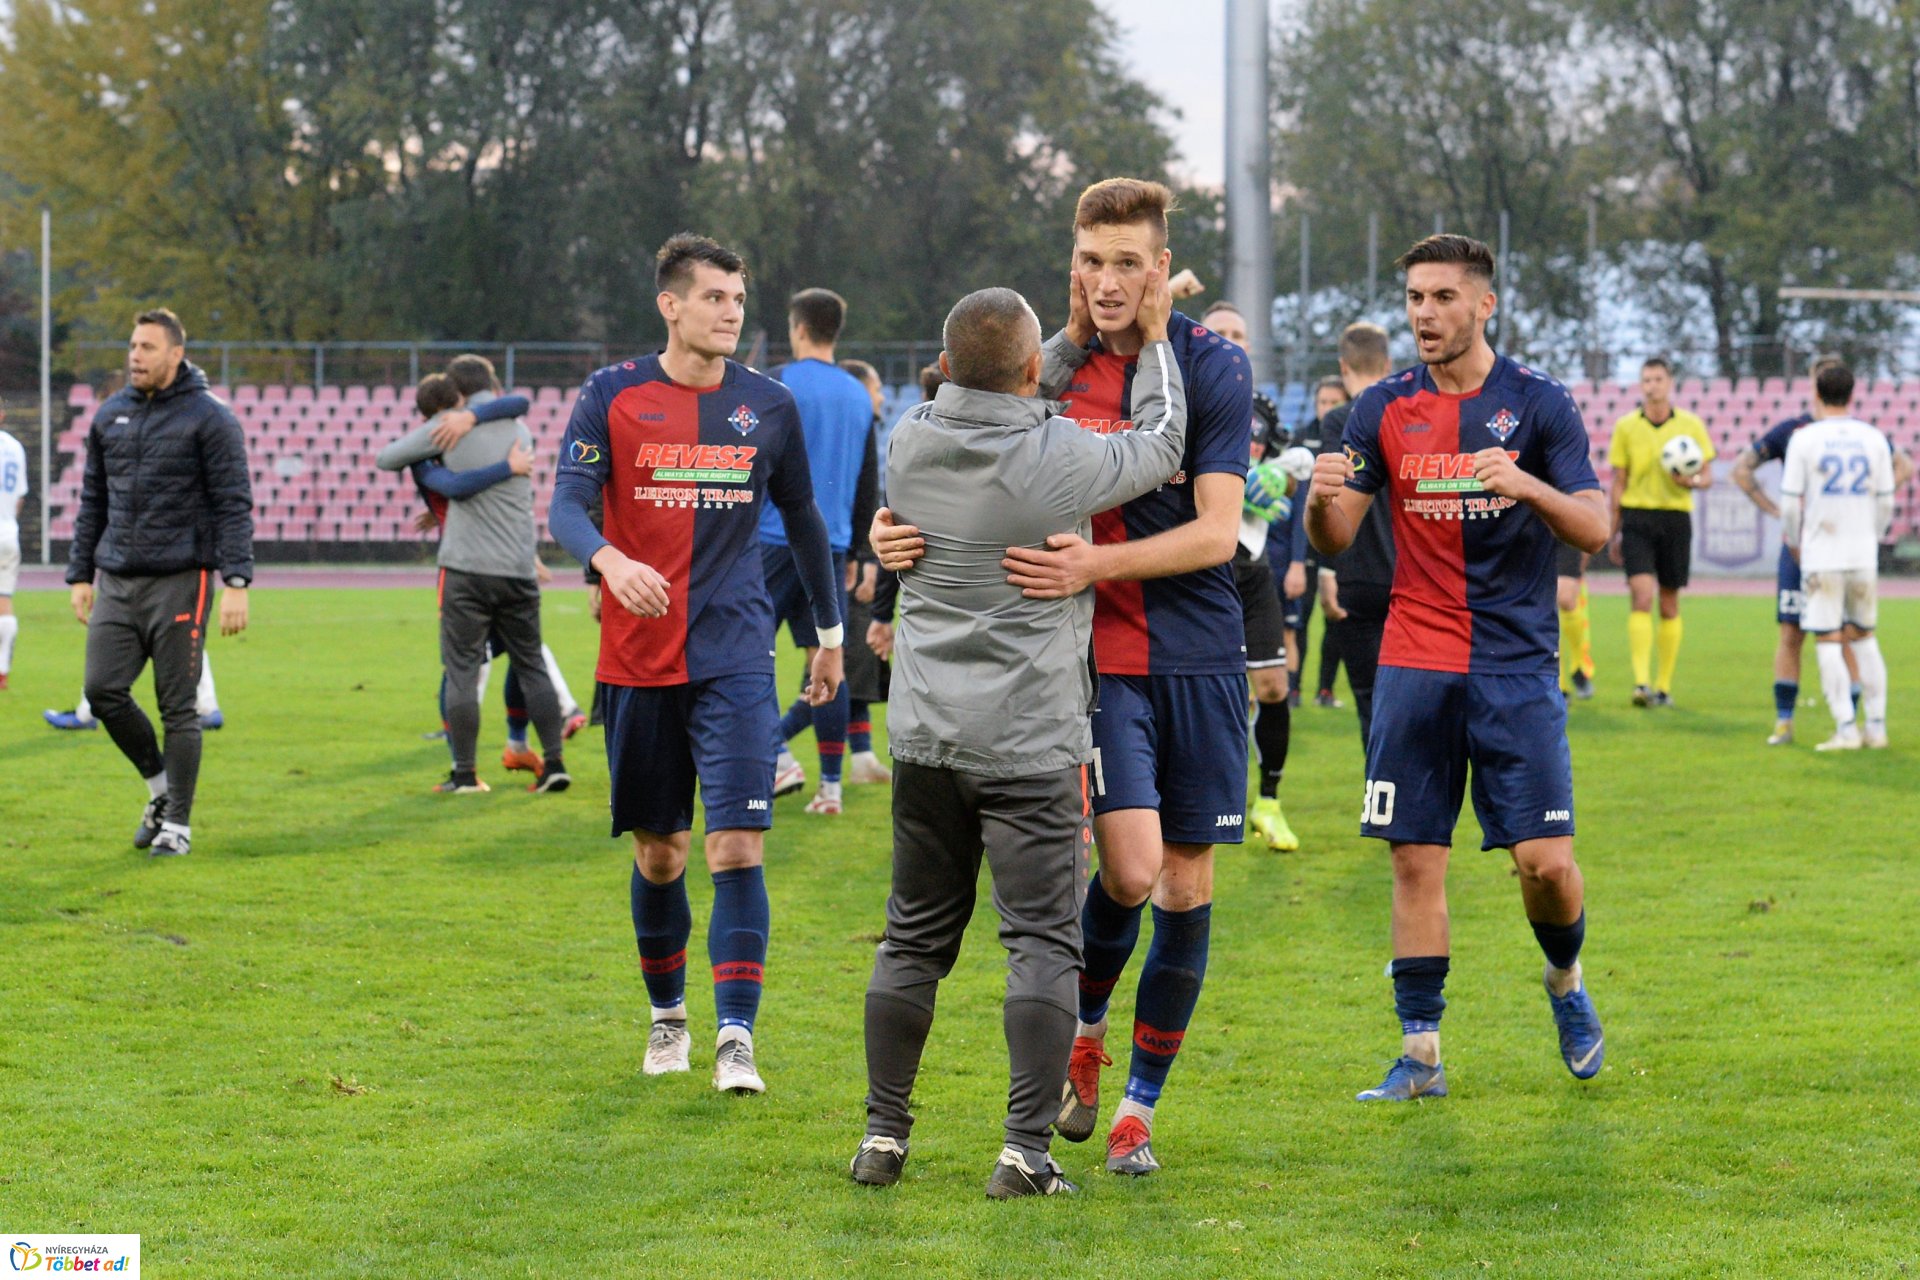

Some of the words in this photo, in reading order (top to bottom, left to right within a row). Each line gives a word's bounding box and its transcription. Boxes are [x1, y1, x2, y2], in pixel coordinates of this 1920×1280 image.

[1399, 451, 1520, 480] REVE
[655, 470, 684, 478] ALWAYS
[696, 471, 709, 479] THE
[1819, 454, 1869, 495] 22
[1420, 482, 1446, 490] ALWAYS
[1447, 481, 1458, 489] ON
[634, 486, 699, 501] LERTON
[701, 488, 754, 503] TRANS
[655, 500, 734, 509] HUNGARY
[1215, 814, 1243, 827] JAKO
[1544, 809, 1570, 822] JAKO
